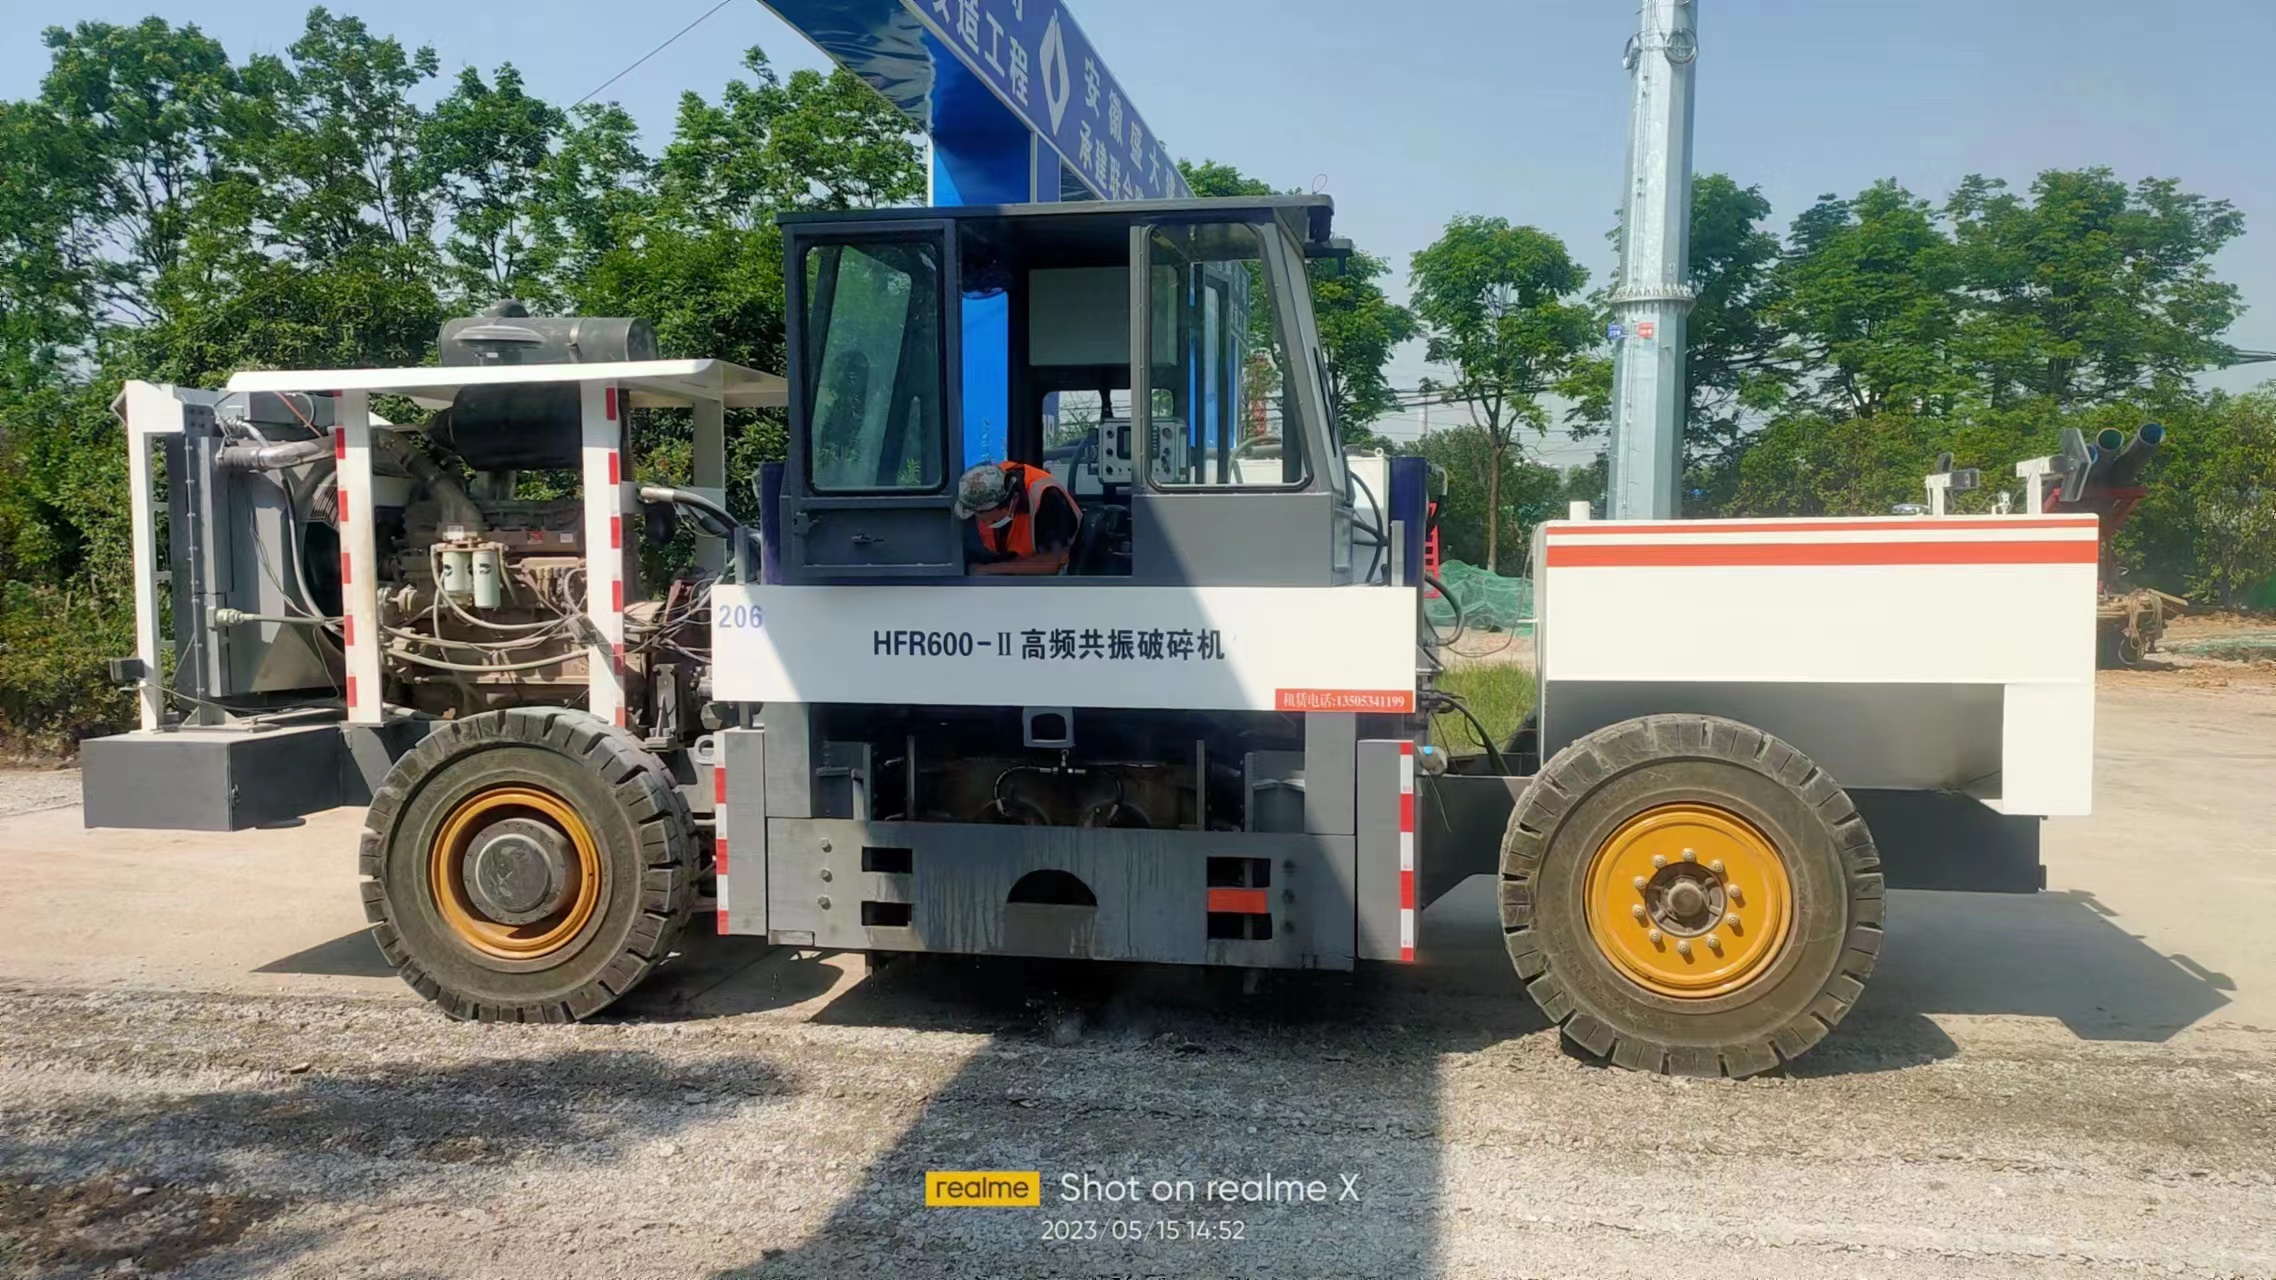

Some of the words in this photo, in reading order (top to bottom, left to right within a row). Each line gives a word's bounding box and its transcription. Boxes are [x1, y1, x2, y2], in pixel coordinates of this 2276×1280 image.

[932, 0, 1029, 107] 造工程
[719, 605, 762, 628] 206
[1020, 628, 1225, 660] 高频共振破碎机
